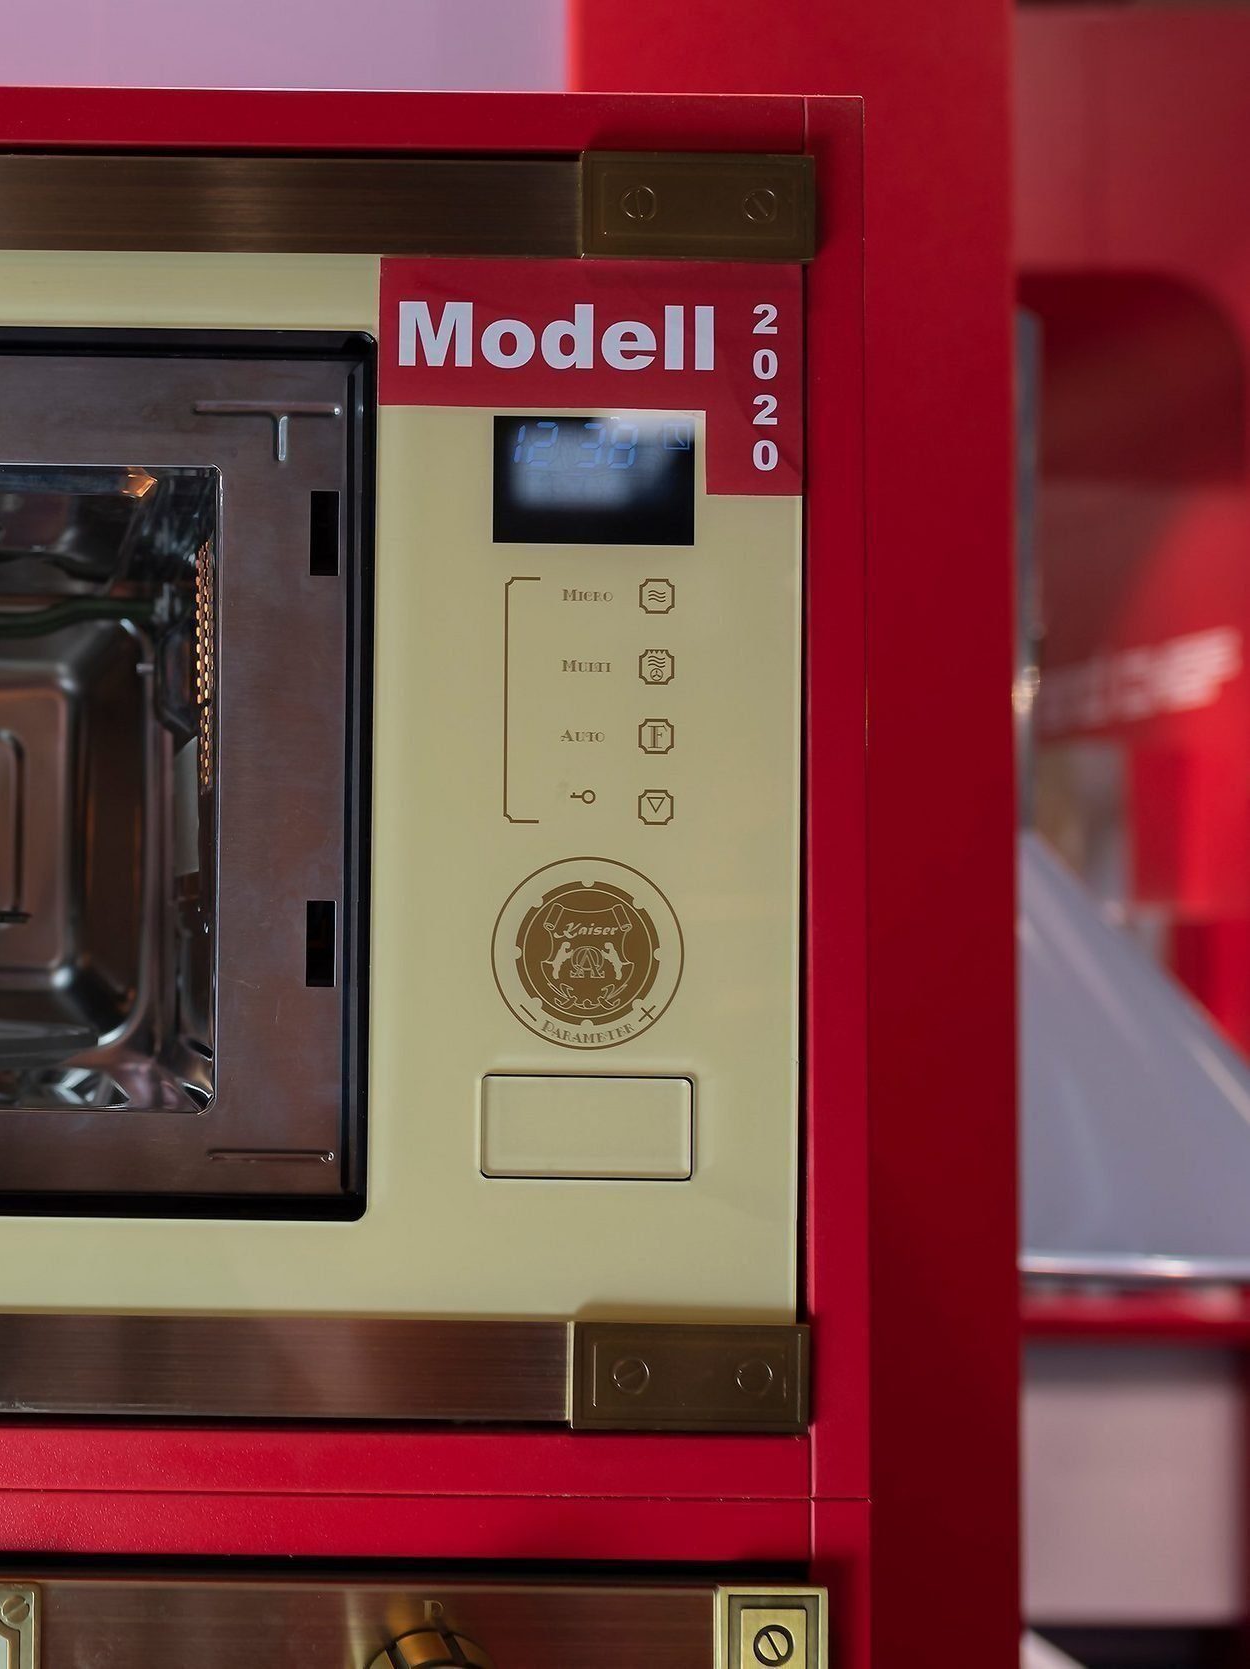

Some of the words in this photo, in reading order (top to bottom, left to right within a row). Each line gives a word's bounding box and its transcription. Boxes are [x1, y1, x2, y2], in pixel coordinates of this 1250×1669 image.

[398, 301, 715, 371] Modell
[752, 303, 779, 471] 2020
[553, 922, 618, 939] Kaiser
[541, 1020, 634, 1043] PARAMETER
